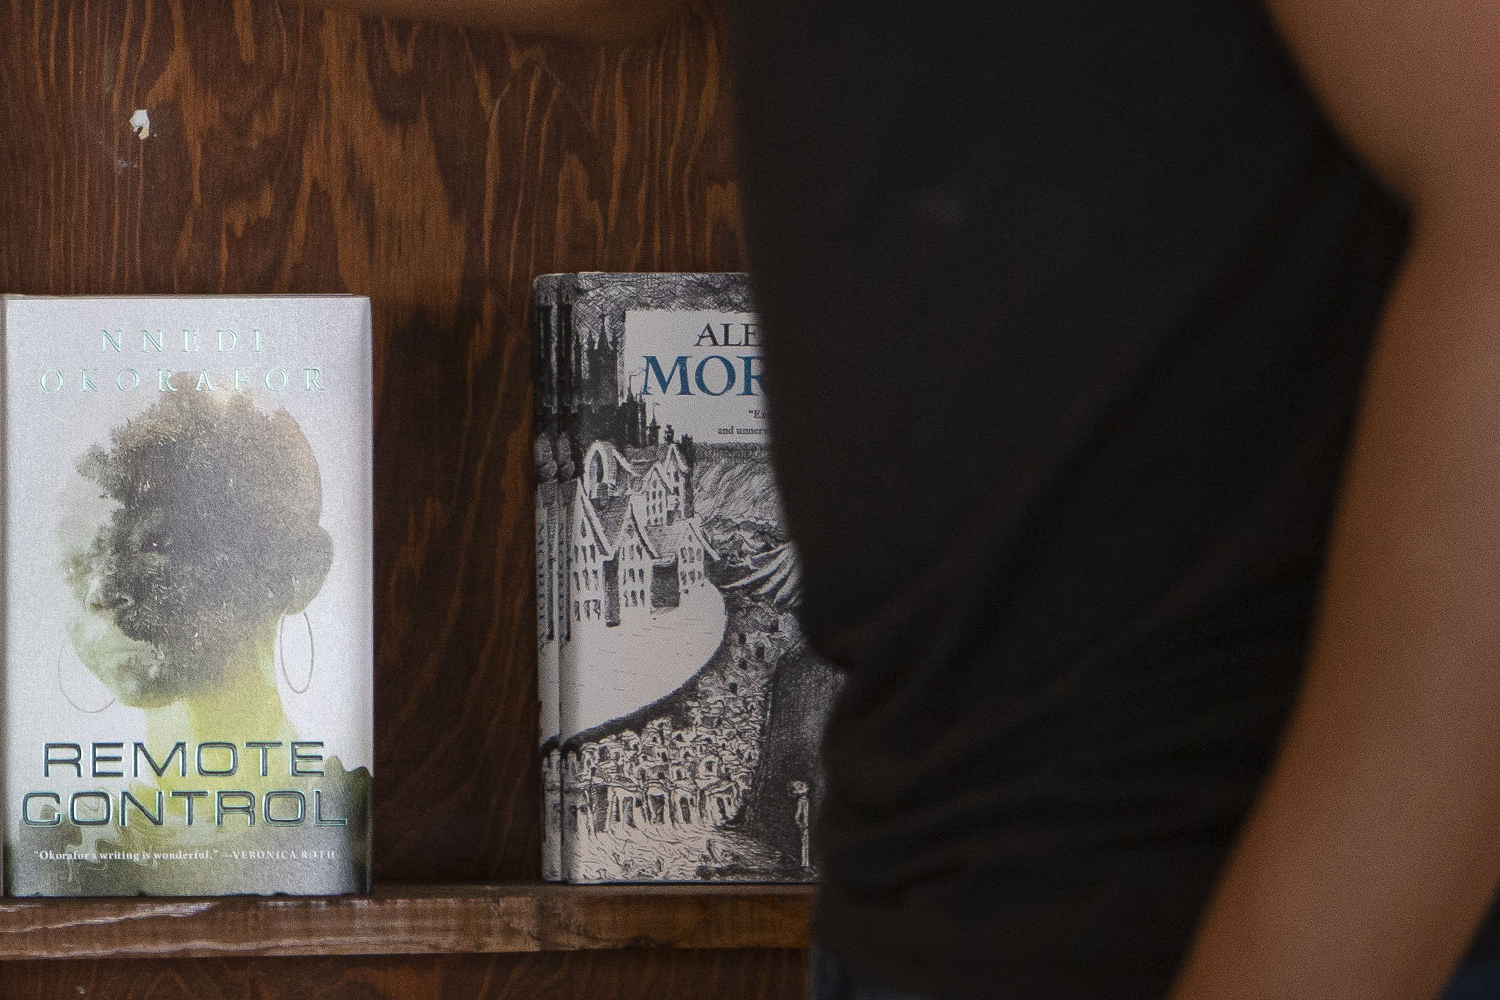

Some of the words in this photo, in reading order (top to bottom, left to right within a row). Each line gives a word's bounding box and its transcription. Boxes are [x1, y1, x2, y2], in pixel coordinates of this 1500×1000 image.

[100, 328, 264, 354] NNEDI
[39, 367, 326, 393] OKORAFOR
[717, 424, 735, 435] and
[42, 741, 326, 778] REMOTE
[21, 788, 349, 828] CONTROL
[99, 849, 140, 863] writing
[142, 850, 151, 860] is
[300, 850, 336, 860] ROTH
